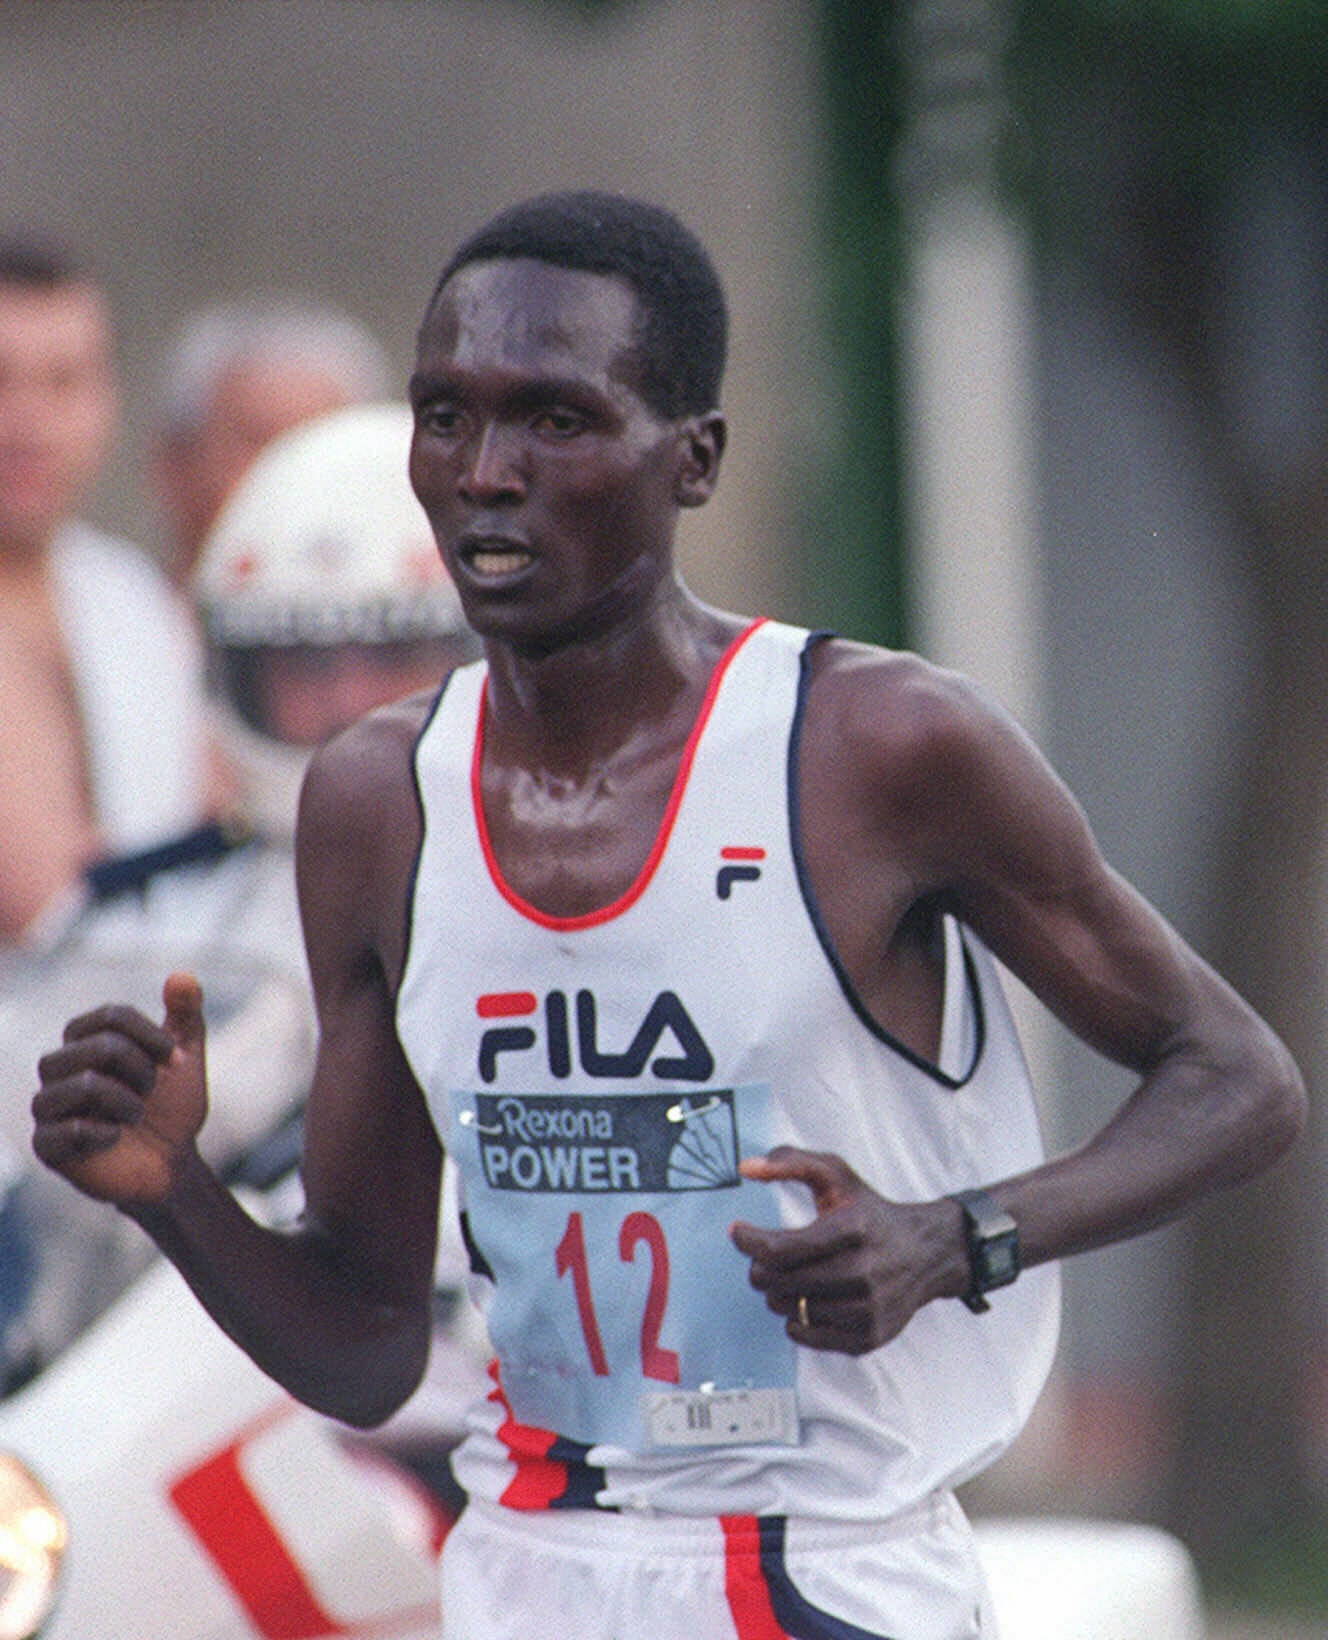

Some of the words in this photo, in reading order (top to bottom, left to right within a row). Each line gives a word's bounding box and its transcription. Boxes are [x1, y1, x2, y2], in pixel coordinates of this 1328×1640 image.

[475, 988, 715, 1083] FILA
[498, 1099, 612, 1142] Rexona
[485, 1146, 640, 1189] POWER
[555, 1211, 680, 1384] 12
